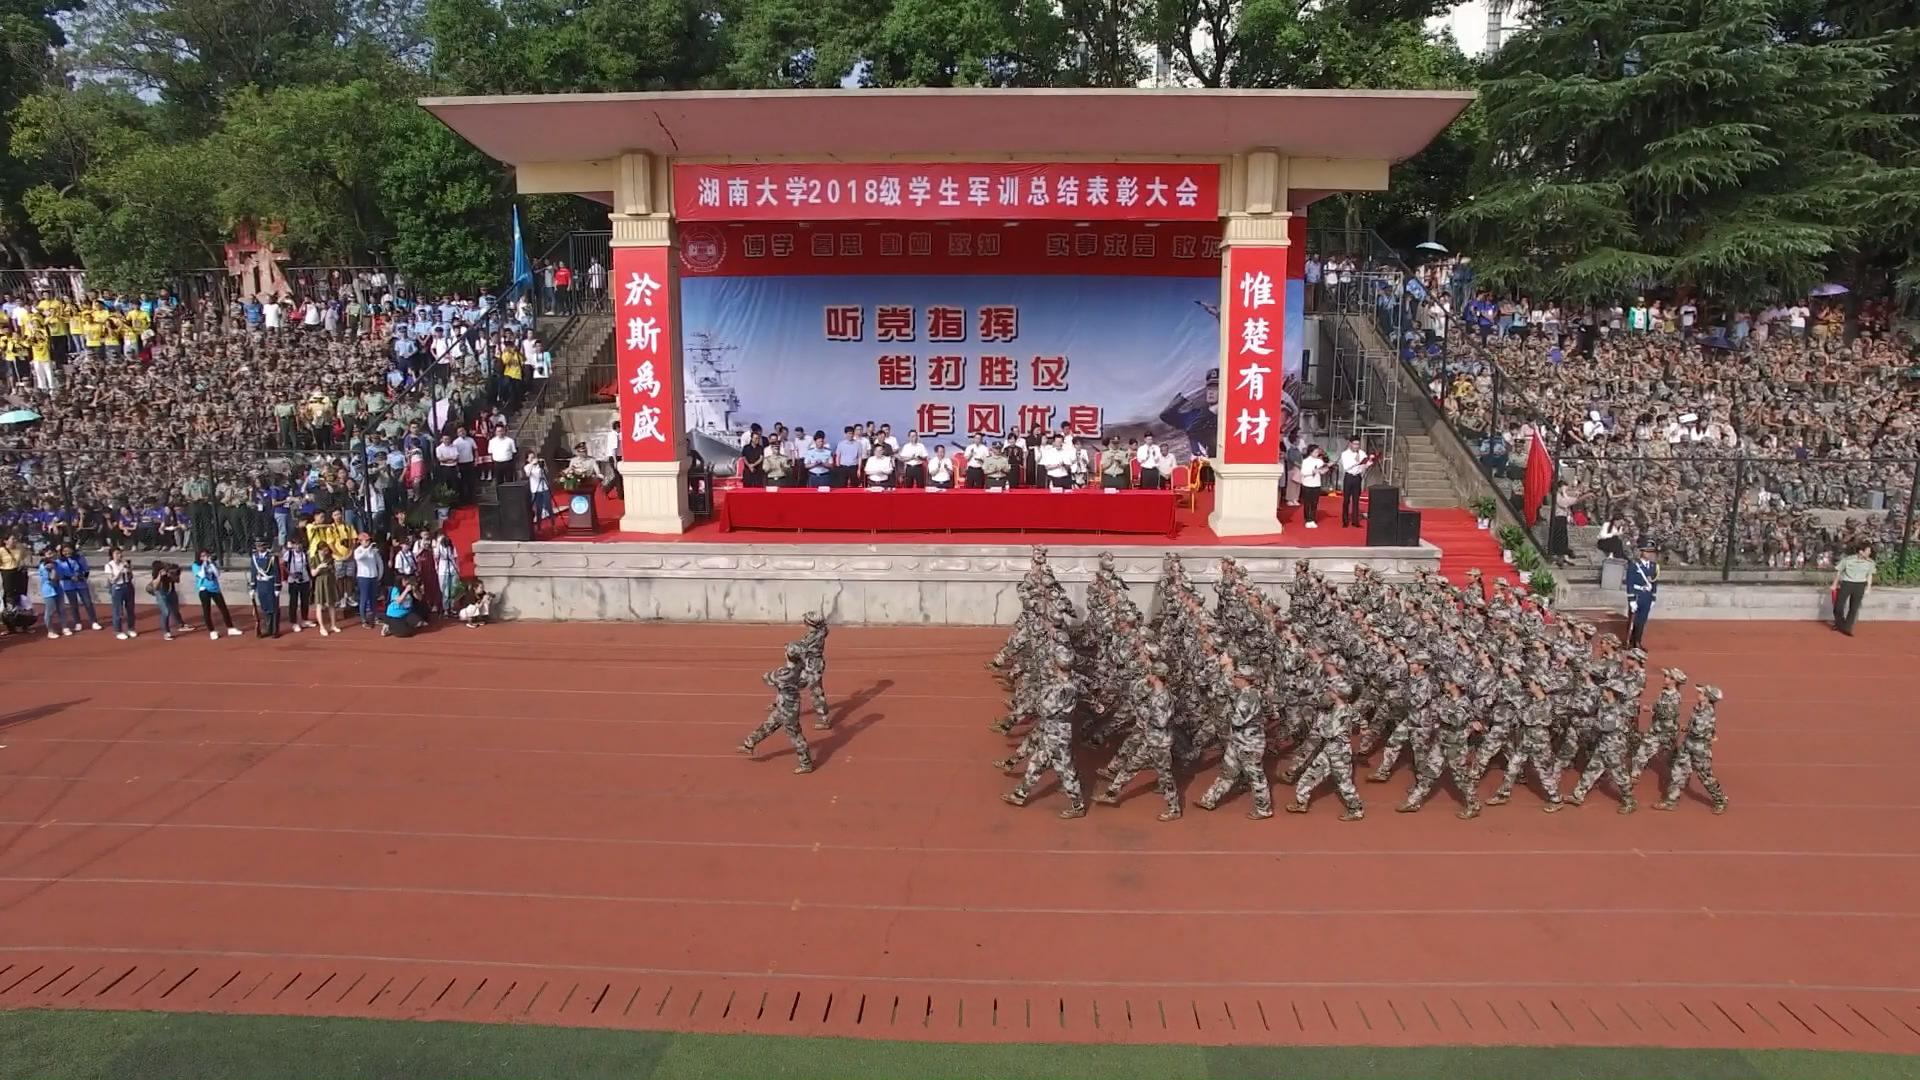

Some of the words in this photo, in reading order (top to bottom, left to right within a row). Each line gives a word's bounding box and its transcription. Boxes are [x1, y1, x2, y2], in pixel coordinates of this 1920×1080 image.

[698, 176, 1199, 208] 湖南大学2018级学生军训总结表彰大会
[825, 305, 1019, 341] 听党指挥
[877, 355, 1068, 390] 能打胜仗
[1233, 271, 1276, 445] 惟楚有材
[916, 403, 1103, 438] 作风优良
